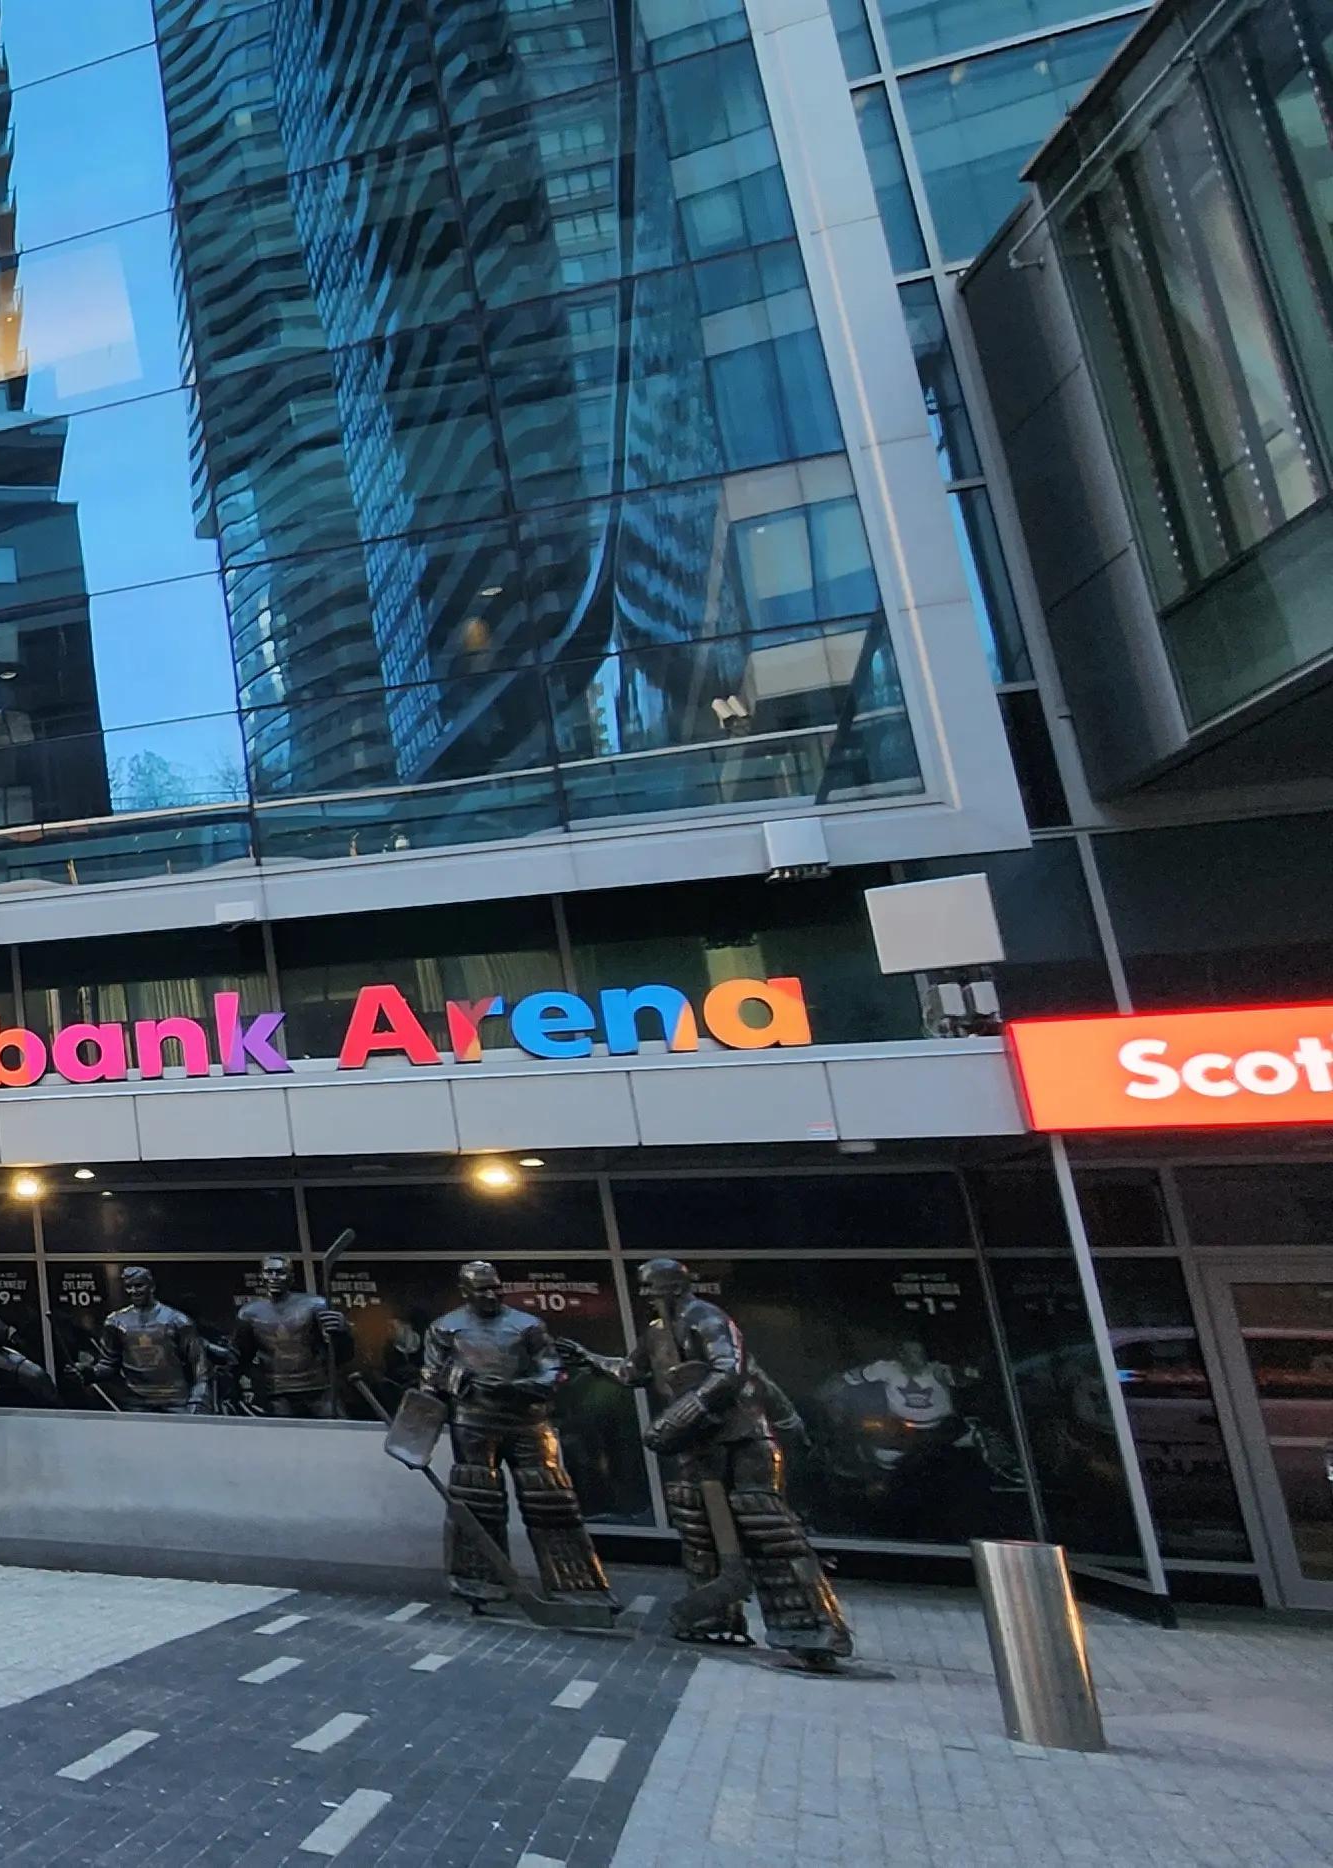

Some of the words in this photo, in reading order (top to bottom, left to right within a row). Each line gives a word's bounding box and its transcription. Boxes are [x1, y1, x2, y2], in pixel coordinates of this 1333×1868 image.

[337, 976, 813, 1071] Arena
[1117, 1036, 1333, 1100] Scot
[62, 1280, 76, 1291] SYL
[77, 1280, 96, 1291] APPS
[69, 1291, 91, 1306] 10
[342, 1293, 367, 1308] 14
[536, 1293, 566, 1312] 10
